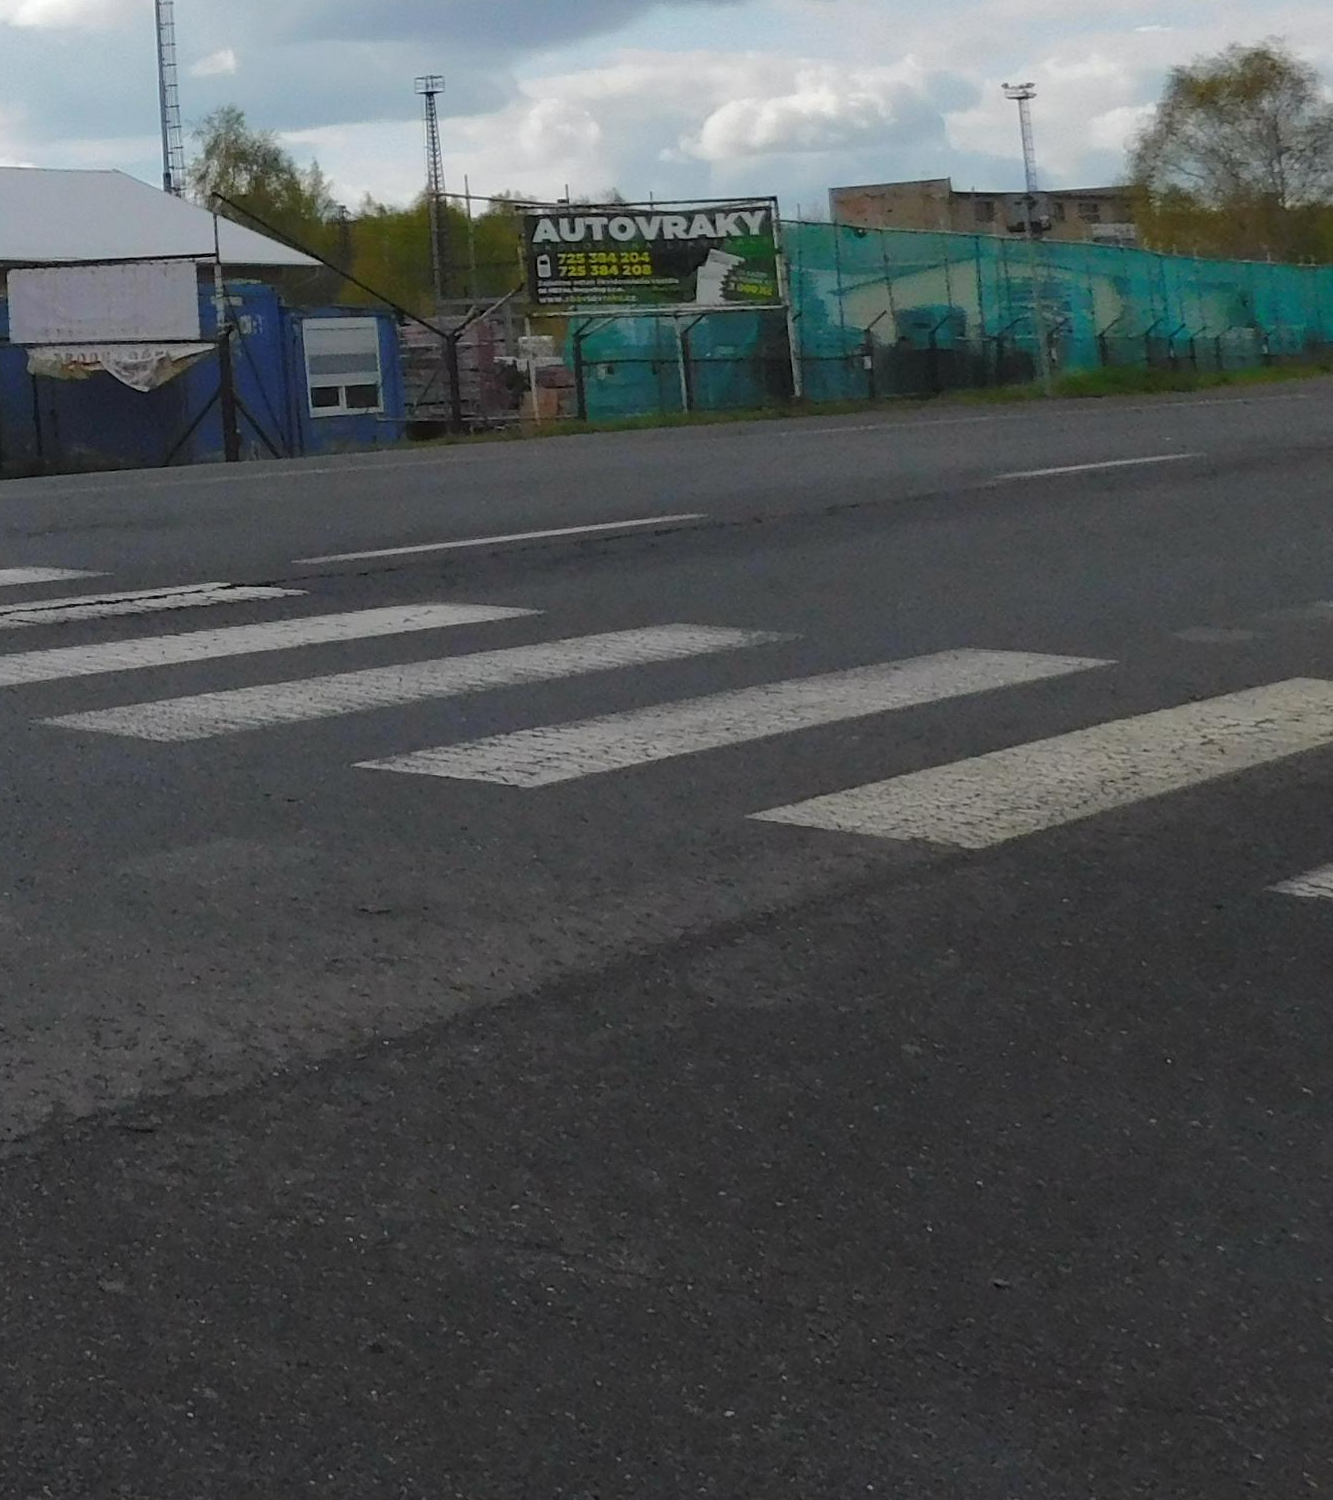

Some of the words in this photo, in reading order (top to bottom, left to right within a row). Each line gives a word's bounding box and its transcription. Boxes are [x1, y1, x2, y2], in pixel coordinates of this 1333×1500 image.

[532, 209, 767, 243] AUTOVRAKY
[557, 253, 585, 264] 725
[620, 251, 650, 263] 204
[558, 266, 586, 277] 725
[590, 265, 619, 276] 384
[622, 264, 652, 276] 208
